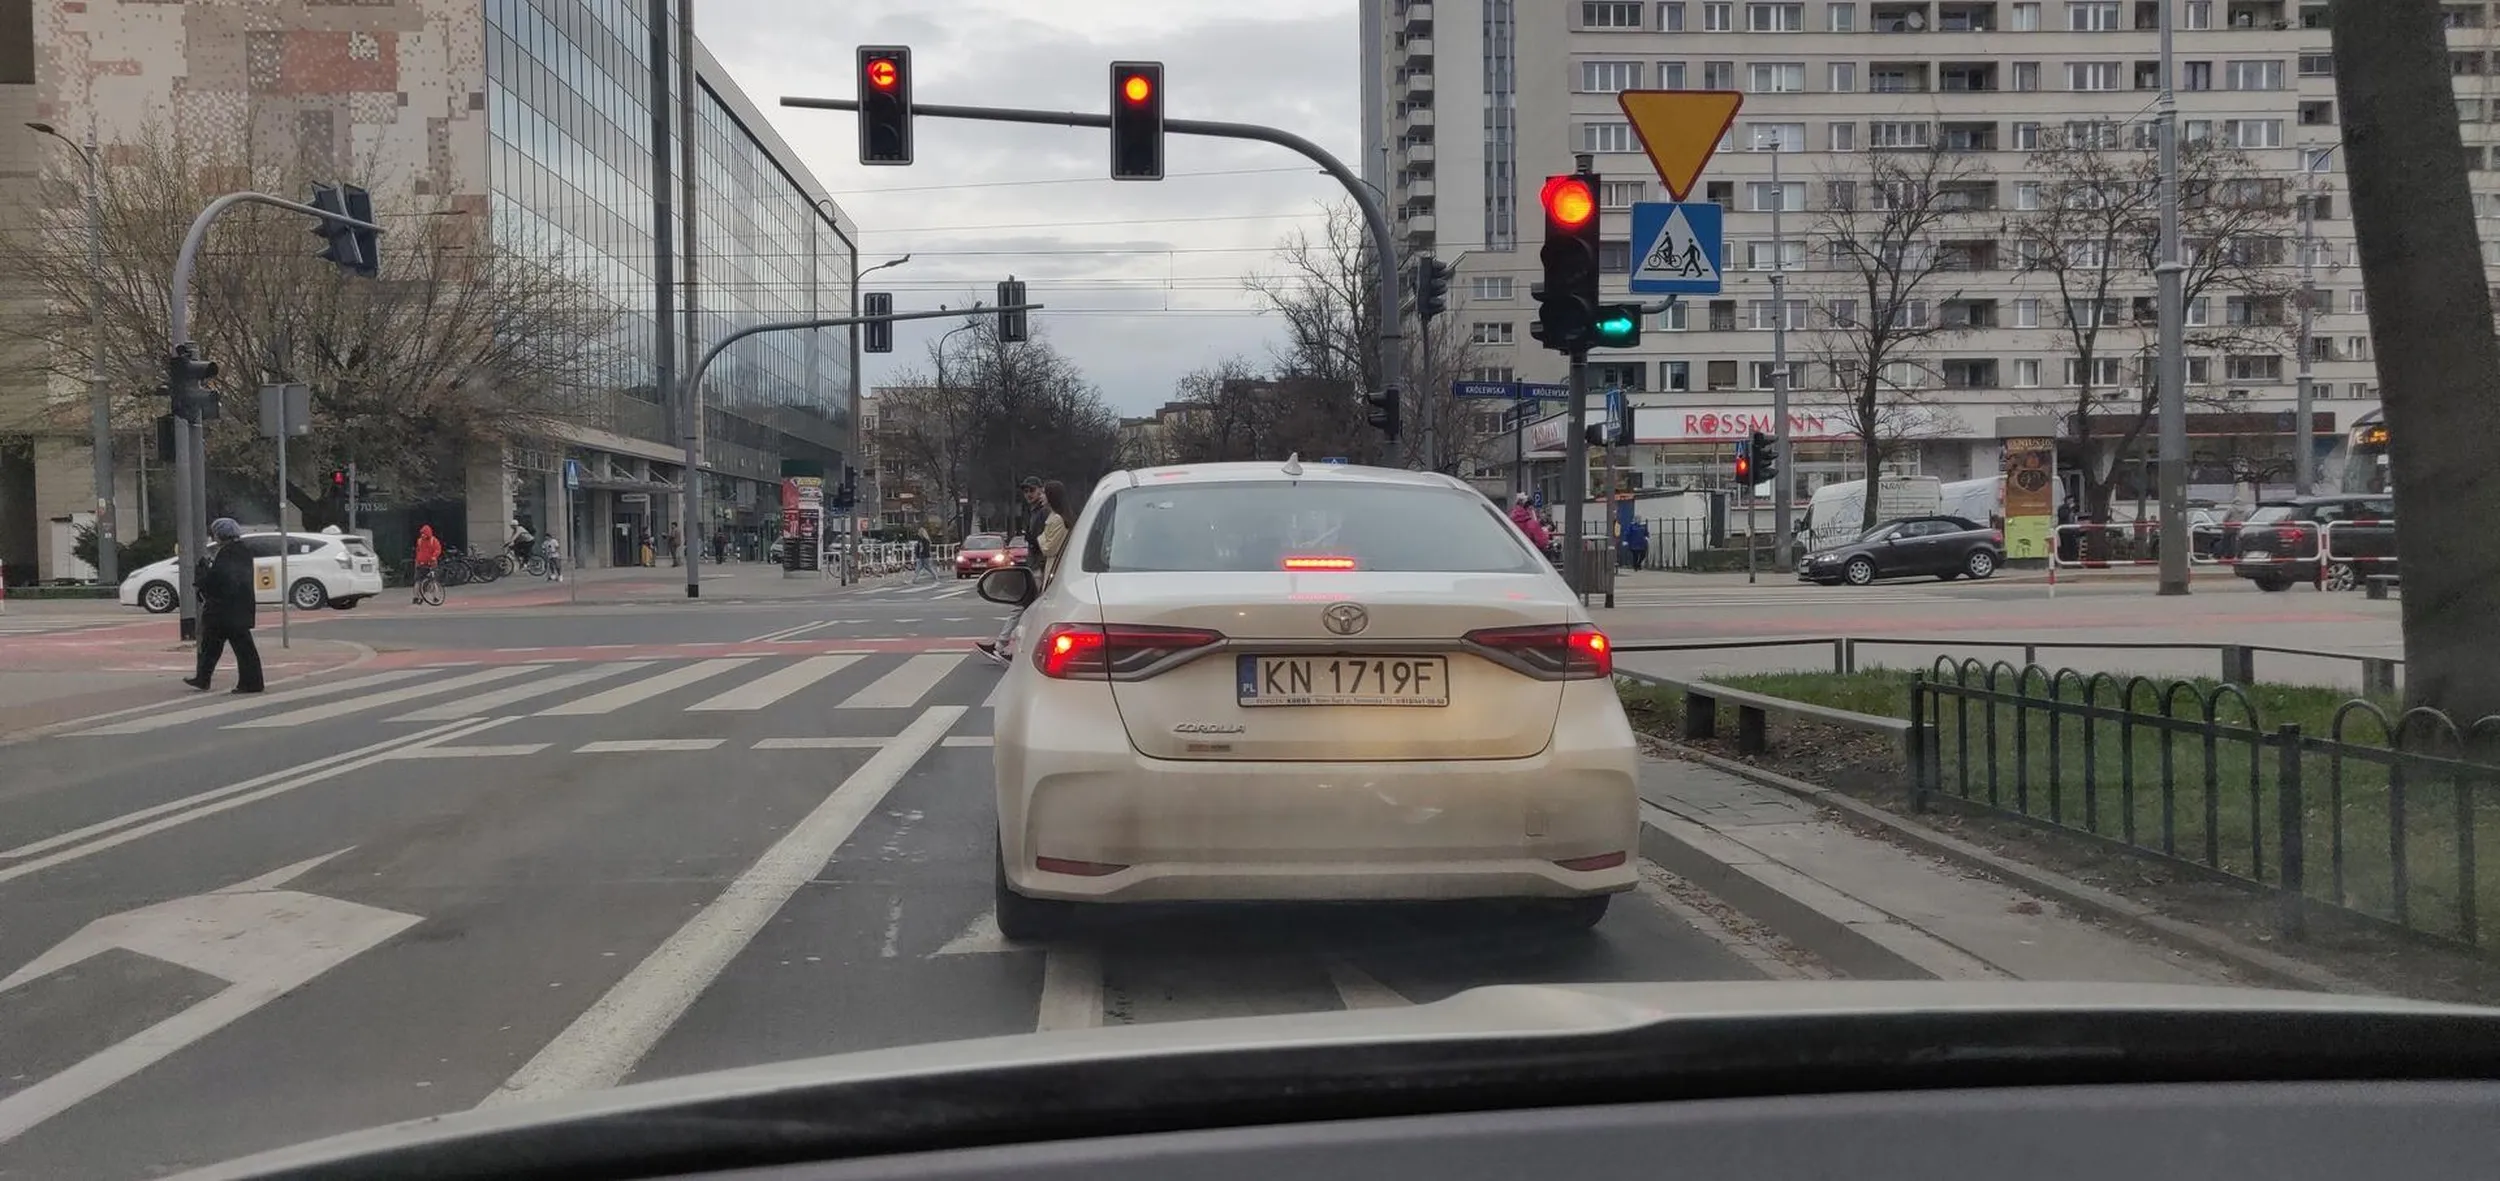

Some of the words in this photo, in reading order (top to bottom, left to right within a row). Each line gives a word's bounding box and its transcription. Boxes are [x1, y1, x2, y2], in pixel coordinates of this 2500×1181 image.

[1465, 385, 1507, 395] KRÓLEWSKA
[1685, 413, 1824, 434] ROSSMNN
[1265, 660, 1312, 695] KN
[1328, 660, 1434, 695] 1719F
[1242, 683, 1257, 693] PL
[1173, 724, 1245, 734] COROLLA
